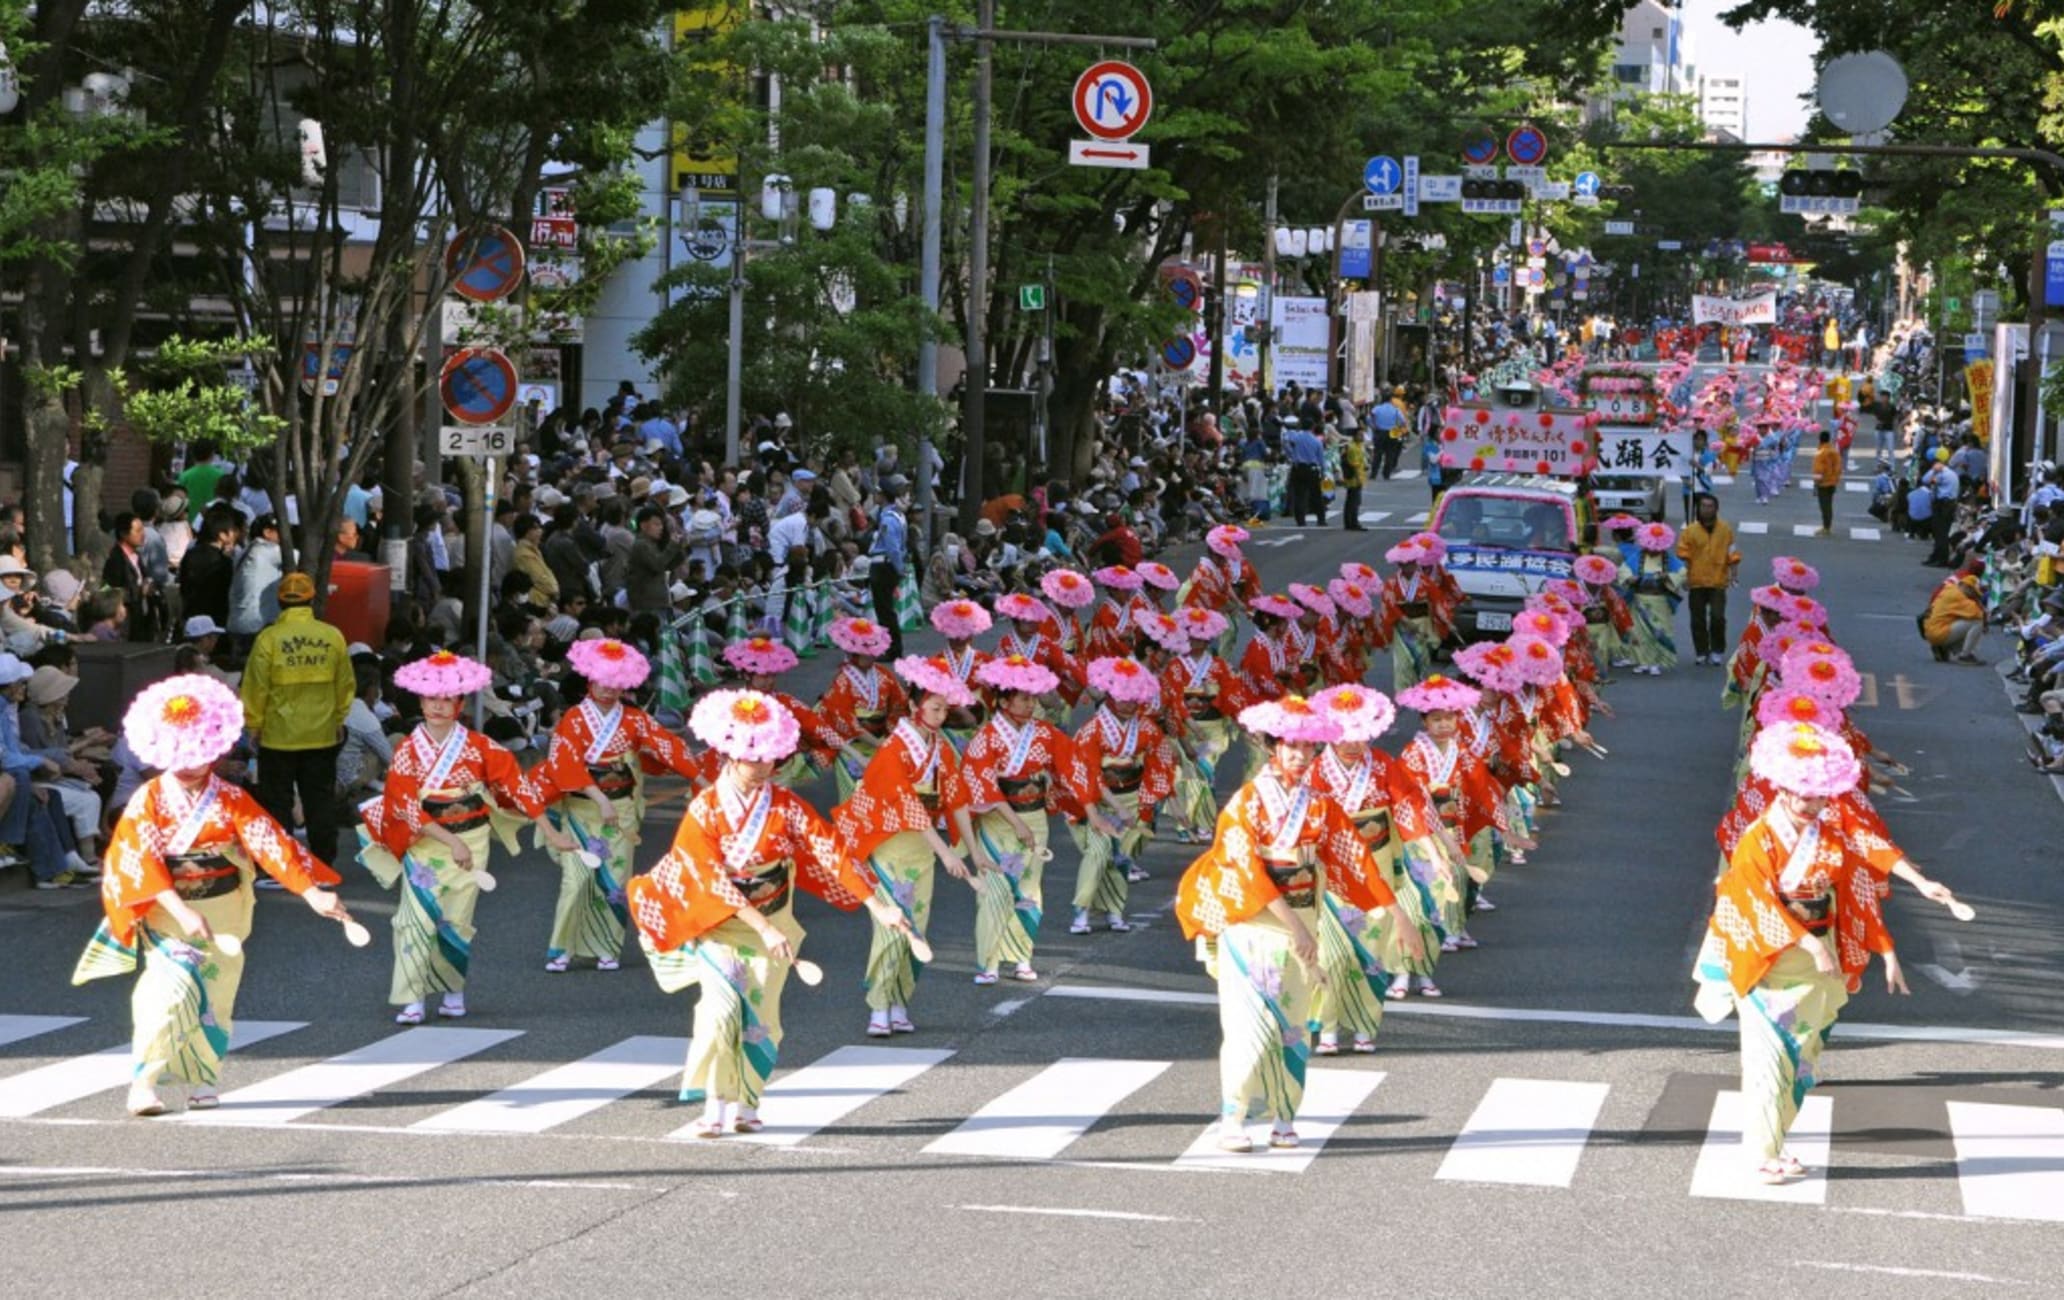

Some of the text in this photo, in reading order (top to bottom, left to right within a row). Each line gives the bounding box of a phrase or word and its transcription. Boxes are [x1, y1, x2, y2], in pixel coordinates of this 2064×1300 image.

[448, 432, 505, 449] 2-16
[1543, 449, 1566, 463] 101
[287, 655, 327, 667] STAFF
